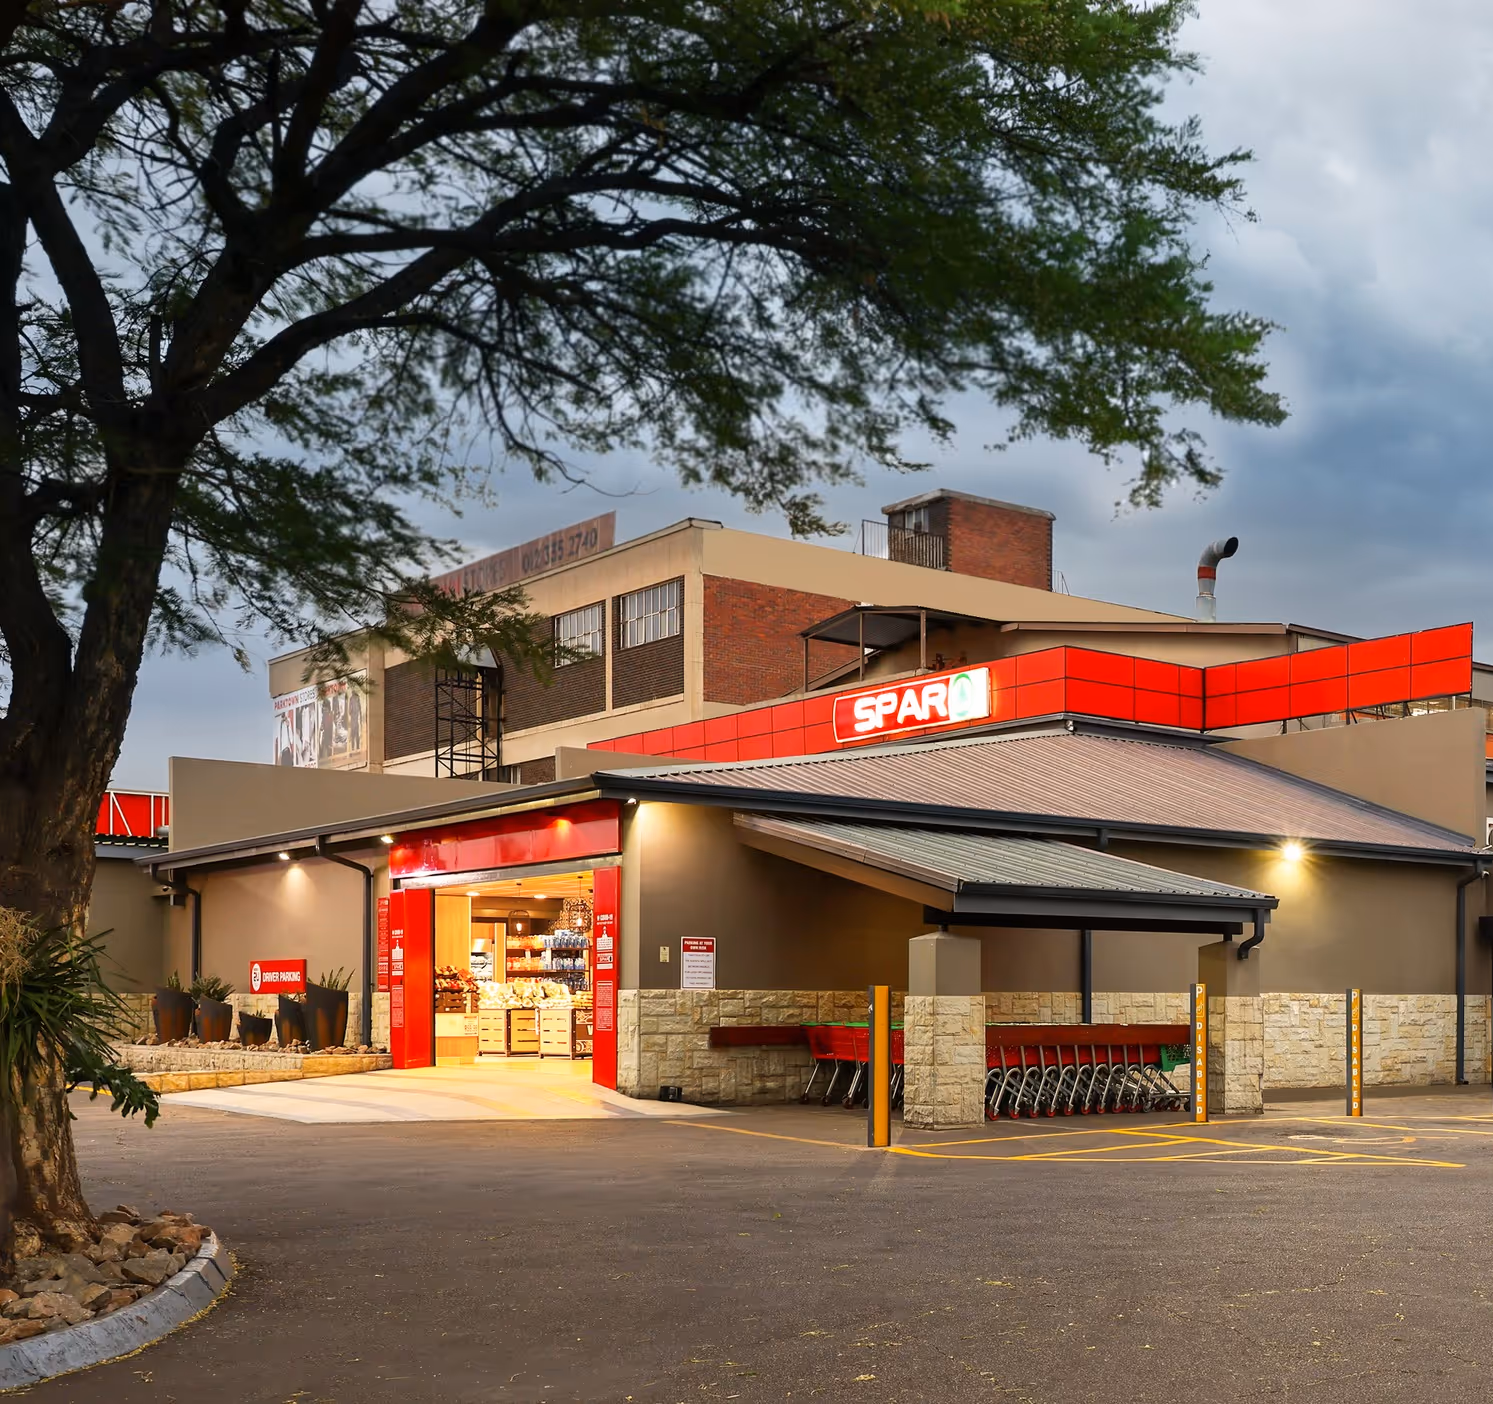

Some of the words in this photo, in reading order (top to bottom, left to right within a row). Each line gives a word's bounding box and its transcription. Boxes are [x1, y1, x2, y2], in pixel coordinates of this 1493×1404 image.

[854, 682, 948, 732] SPAR
[262, 971, 280, 982] DRIVER
[280, 971, 301, 982] PARKING
